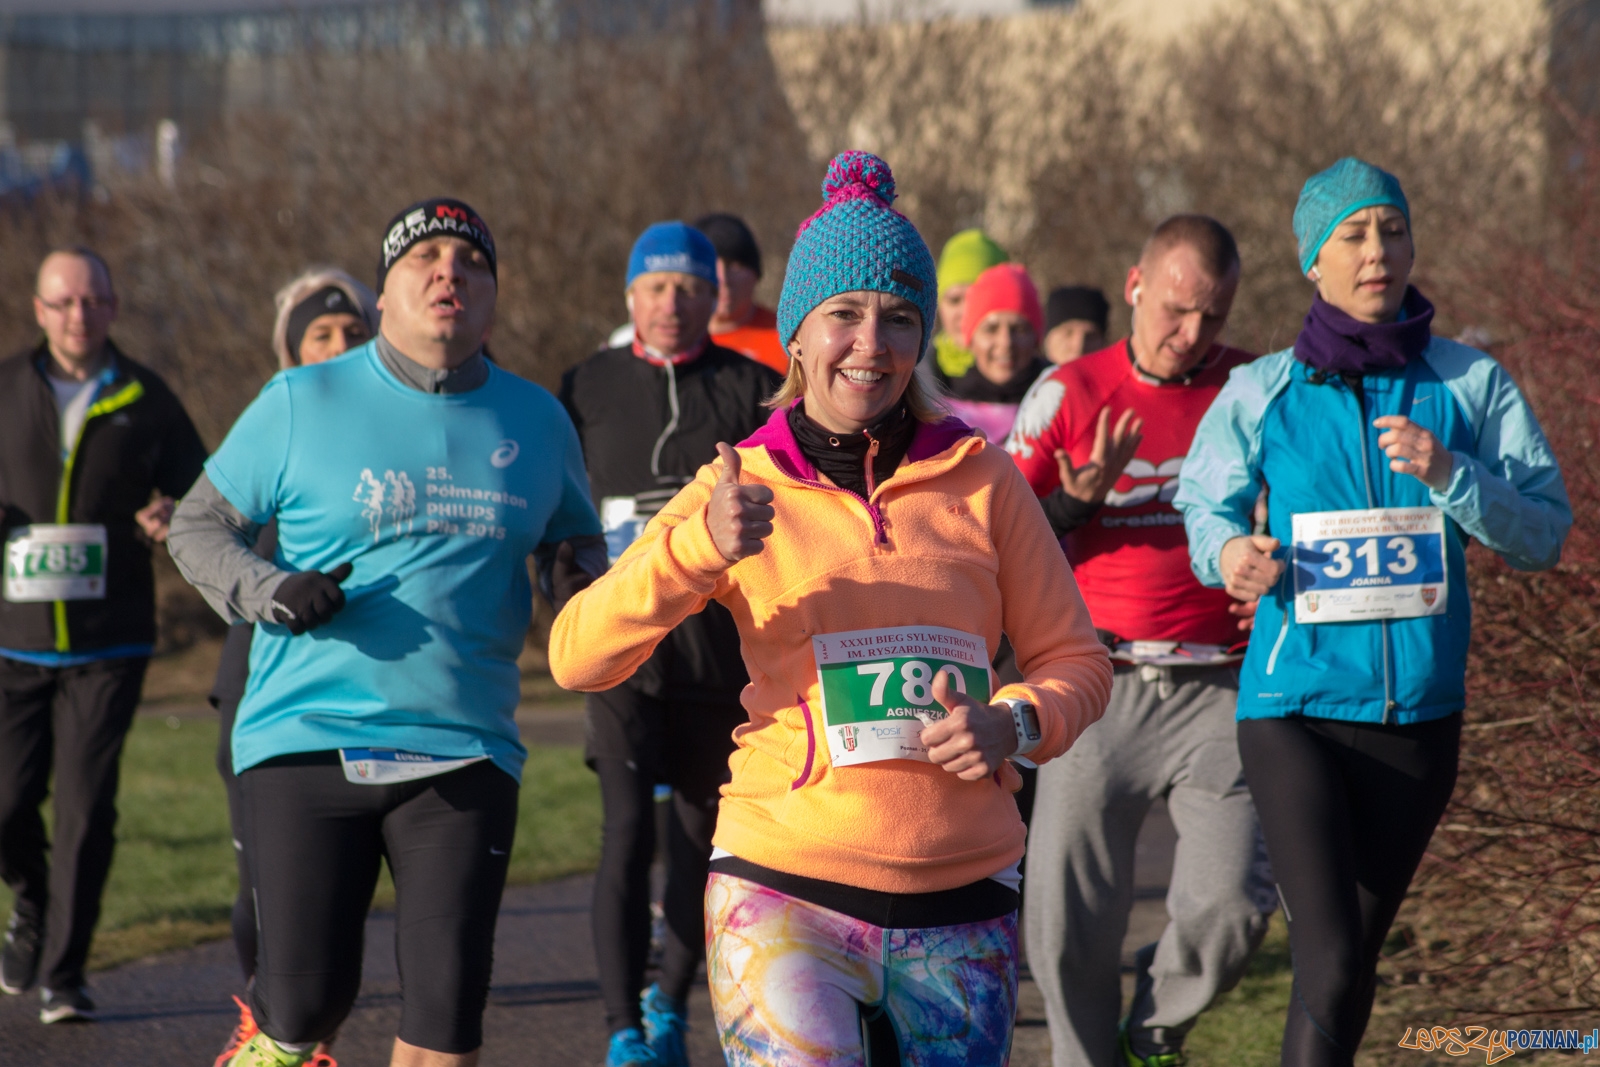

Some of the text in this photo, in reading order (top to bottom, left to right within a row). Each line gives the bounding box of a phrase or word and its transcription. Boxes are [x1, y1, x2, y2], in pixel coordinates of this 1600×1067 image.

[426, 466, 452, 480] 25.
[426, 484, 528, 509] Półmaraton
[426, 502, 495, 521] PHILIPS
[466, 522, 506, 540] 2015
[1332, 526, 1379, 536] RYSZARDA
[1322, 537, 1418, 578] 313
[1350, 576, 1392, 586] JOANNA
[840, 633, 977, 650] XXXII BIEG SYLWESTROWY
[847, 645, 975, 663] IM. RYSZARDA BURGIELA
